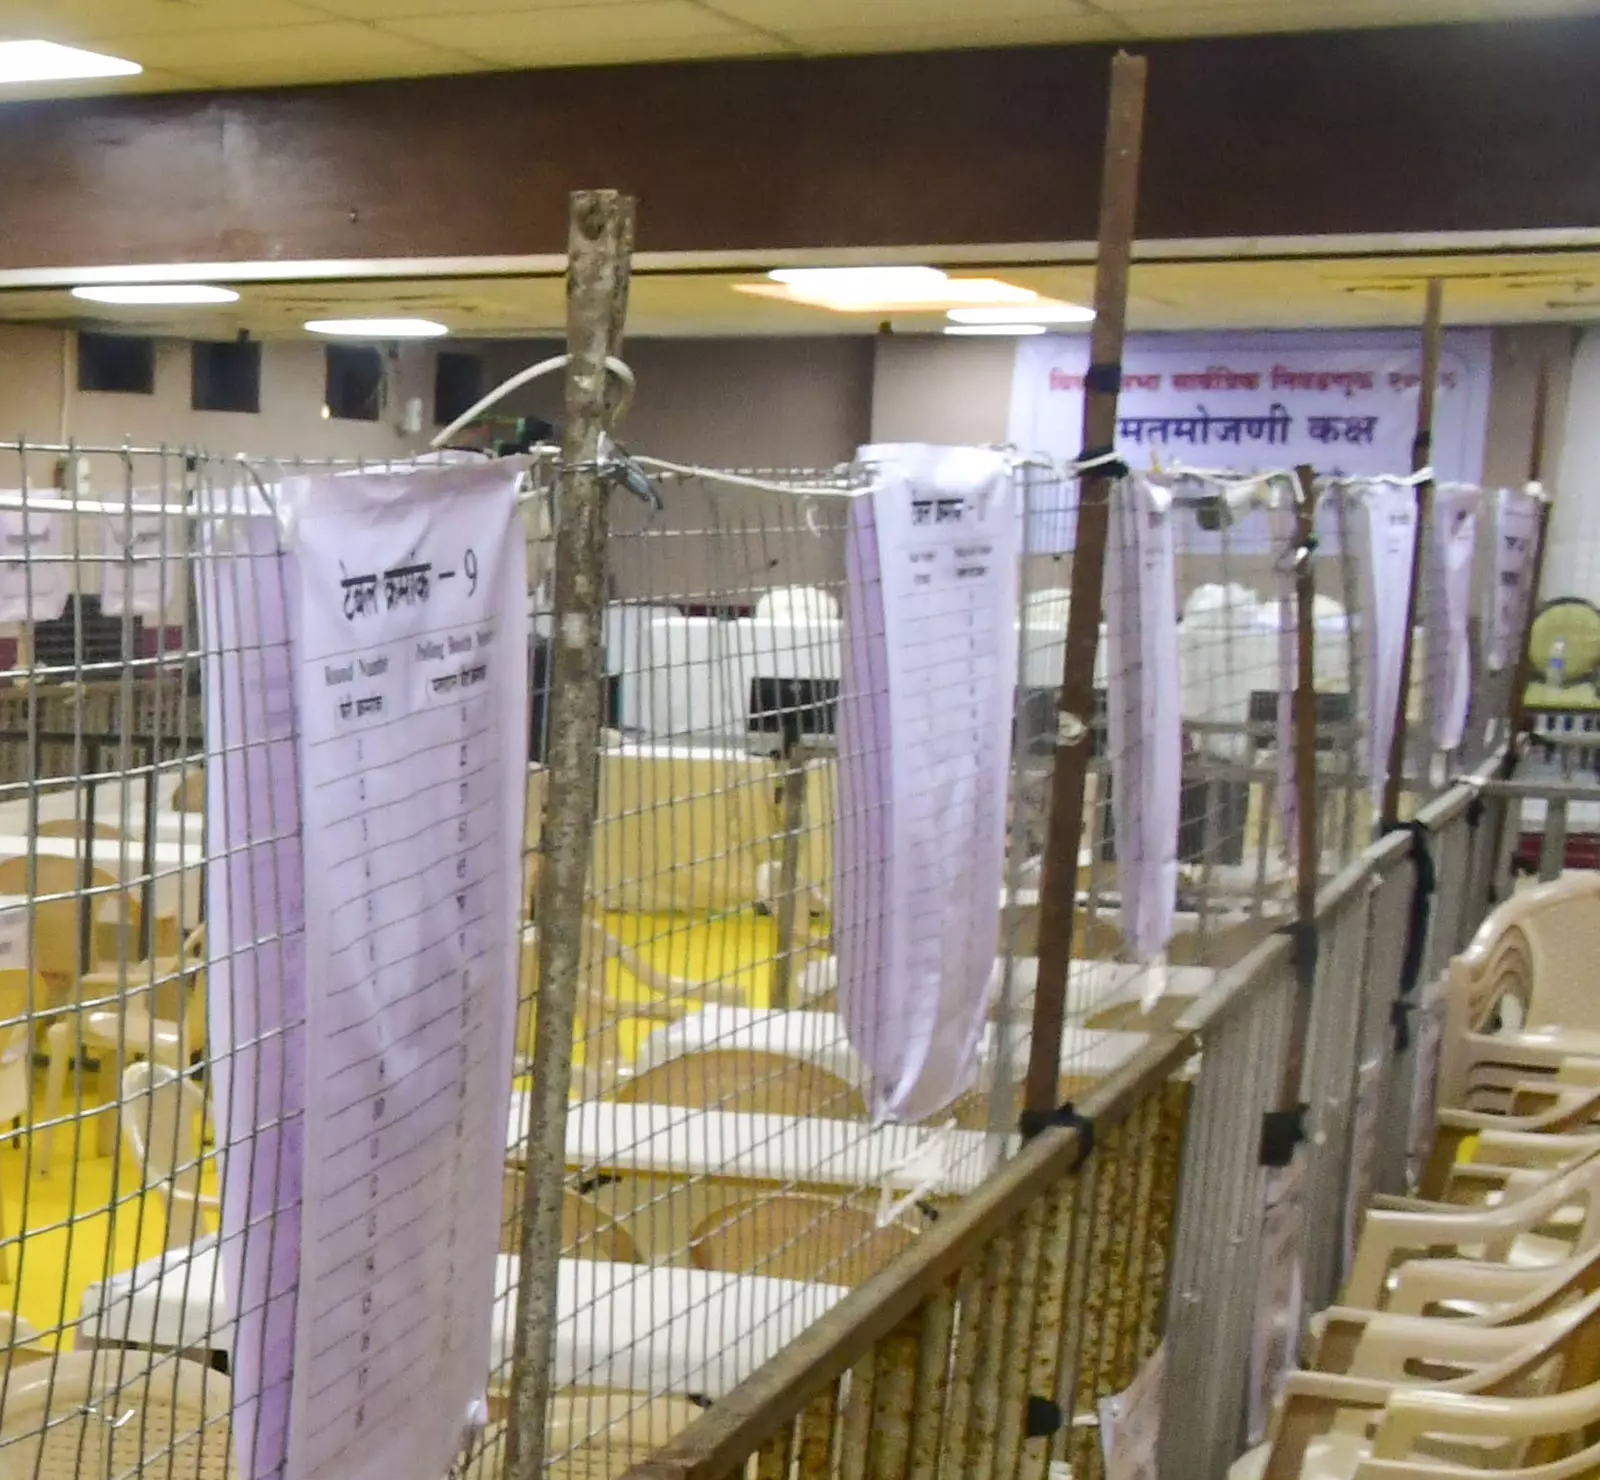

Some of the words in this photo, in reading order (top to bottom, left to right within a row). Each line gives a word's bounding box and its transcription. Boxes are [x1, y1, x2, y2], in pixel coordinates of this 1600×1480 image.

[1119, 402, 1292, 446] मतमोजणी
[1307, 415, 1379, 445] कक्ष
[463, 548, 478, 598] 9
